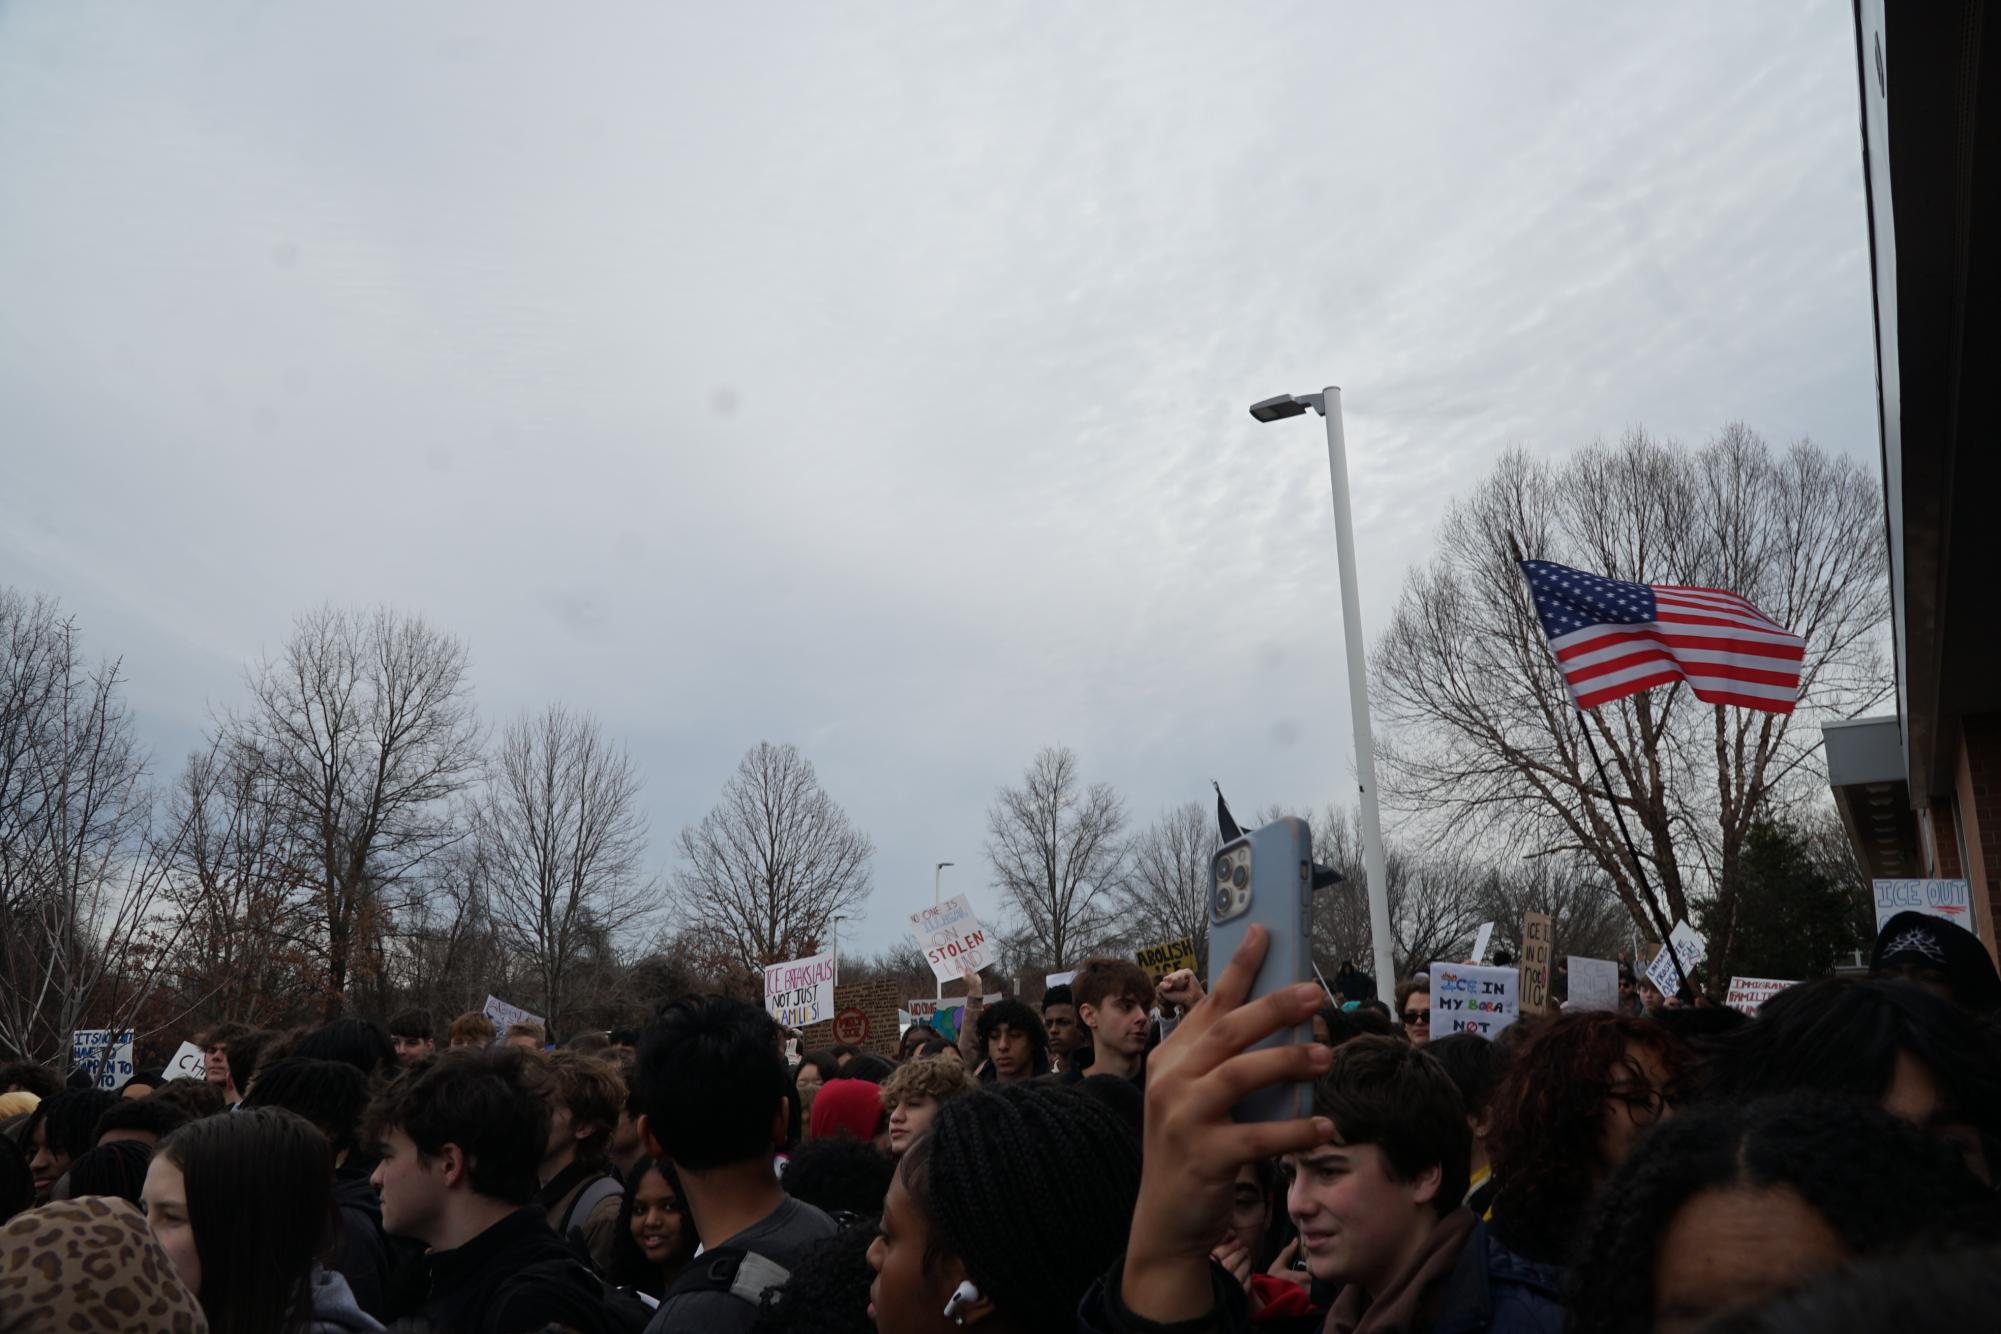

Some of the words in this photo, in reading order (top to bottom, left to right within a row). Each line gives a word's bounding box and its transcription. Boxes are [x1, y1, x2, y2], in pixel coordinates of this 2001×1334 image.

[1875, 880, 1922, 908] ICE
[1927, 880, 1968, 908] OUT
[923, 906, 941, 920] ONE
[944, 900, 958, 911] IS
[932, 926, 958, 946] ON
[1527, 922, 1541, 940] ICE
[928, 930, 985, 964] STOLEN
[1137, 939, 1193, 968] ABOLISH
[943, 950, 983, 977] LAND
[766, 967, 784, 998] ICE
[1440, 978, 1478, 993] ICE
[1481, 982, 1505, 995] IN
[772, 991, 792, 1011] NOT
[794, 985, 819, 1006] JUST
[1440, 996, 1464, 1010] MY
[1453, 1019, 1491, 1033] NOT
[118, 1060, 132, 1074] TO
